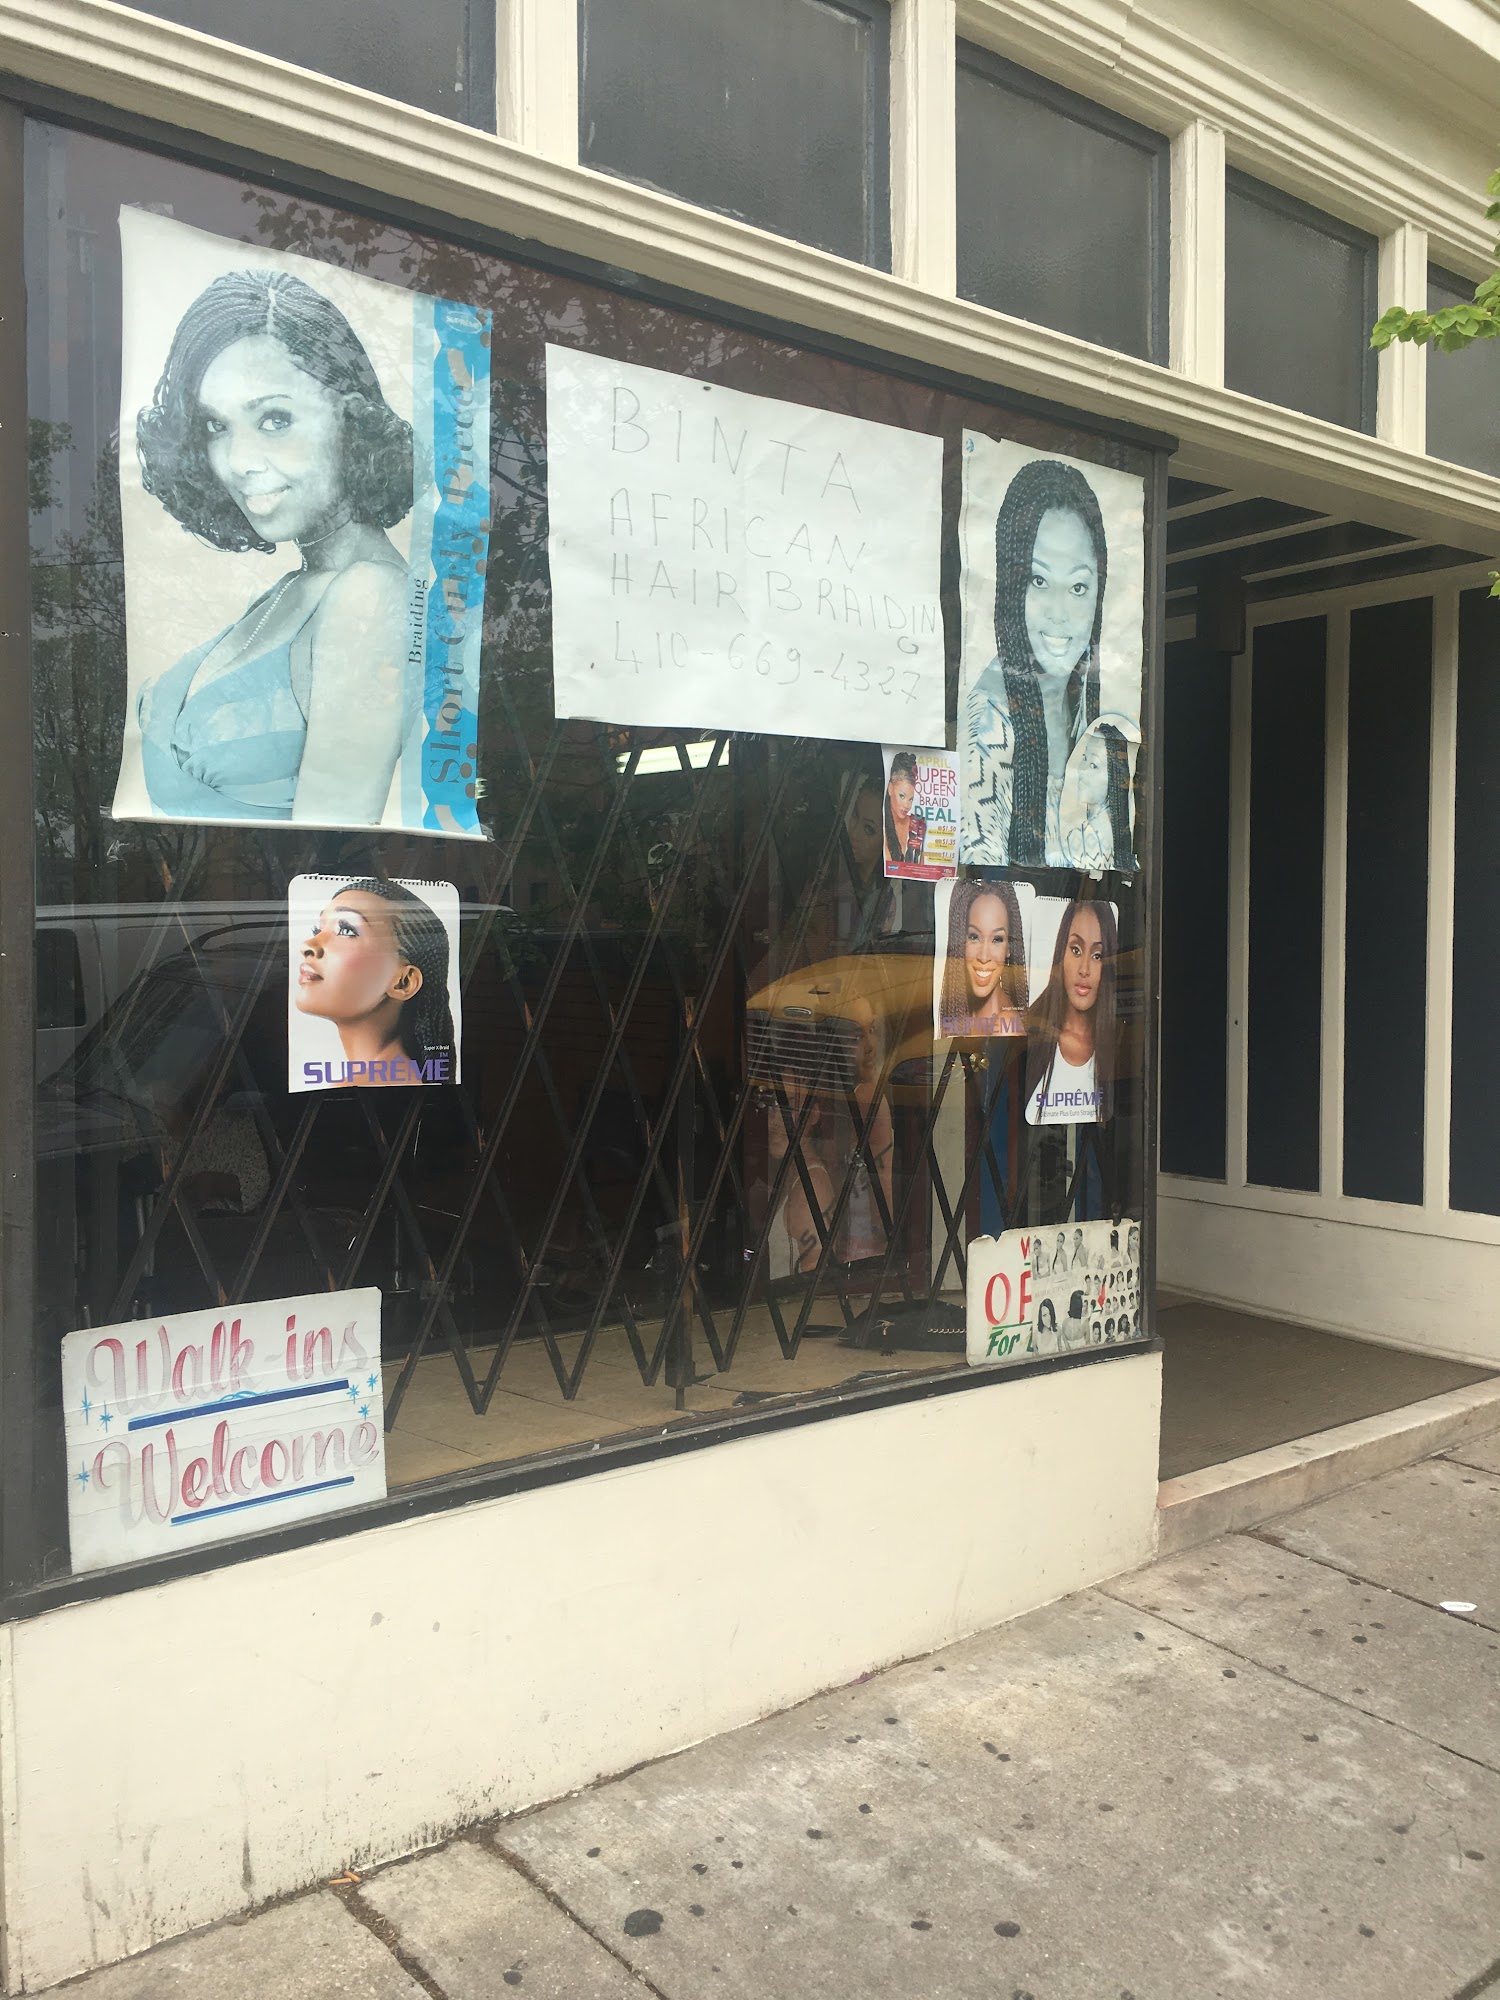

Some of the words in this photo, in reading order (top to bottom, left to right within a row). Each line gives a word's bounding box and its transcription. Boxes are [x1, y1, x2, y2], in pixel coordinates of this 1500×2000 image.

[443, 384, 475, 500] Piece
[611, 386, 862, 514] BINTA
[610, 487, 866, 573] AFRICAN
[434, 519, 481, 646] Curly
[611, 552, 745, 614] HAIR
[408, 578, 429, 664] Braiding
[613, 620, 922, 704] 410-669-4327
[429, 661, 465, 784] Short
[912, 764, 957, 786] SUPER
[914, 781, 956, 798] QUEEN
[917, 755, 951, 769] APRIL
[914, 805, 957, 823] DEAL
[920, 796, 950, 808] BRAID
[303, 1053, 450, 1085] SUPRÊME
[986, 1329, 1021, 1358] For
[92, 1419, 380, 1530] Welcome
